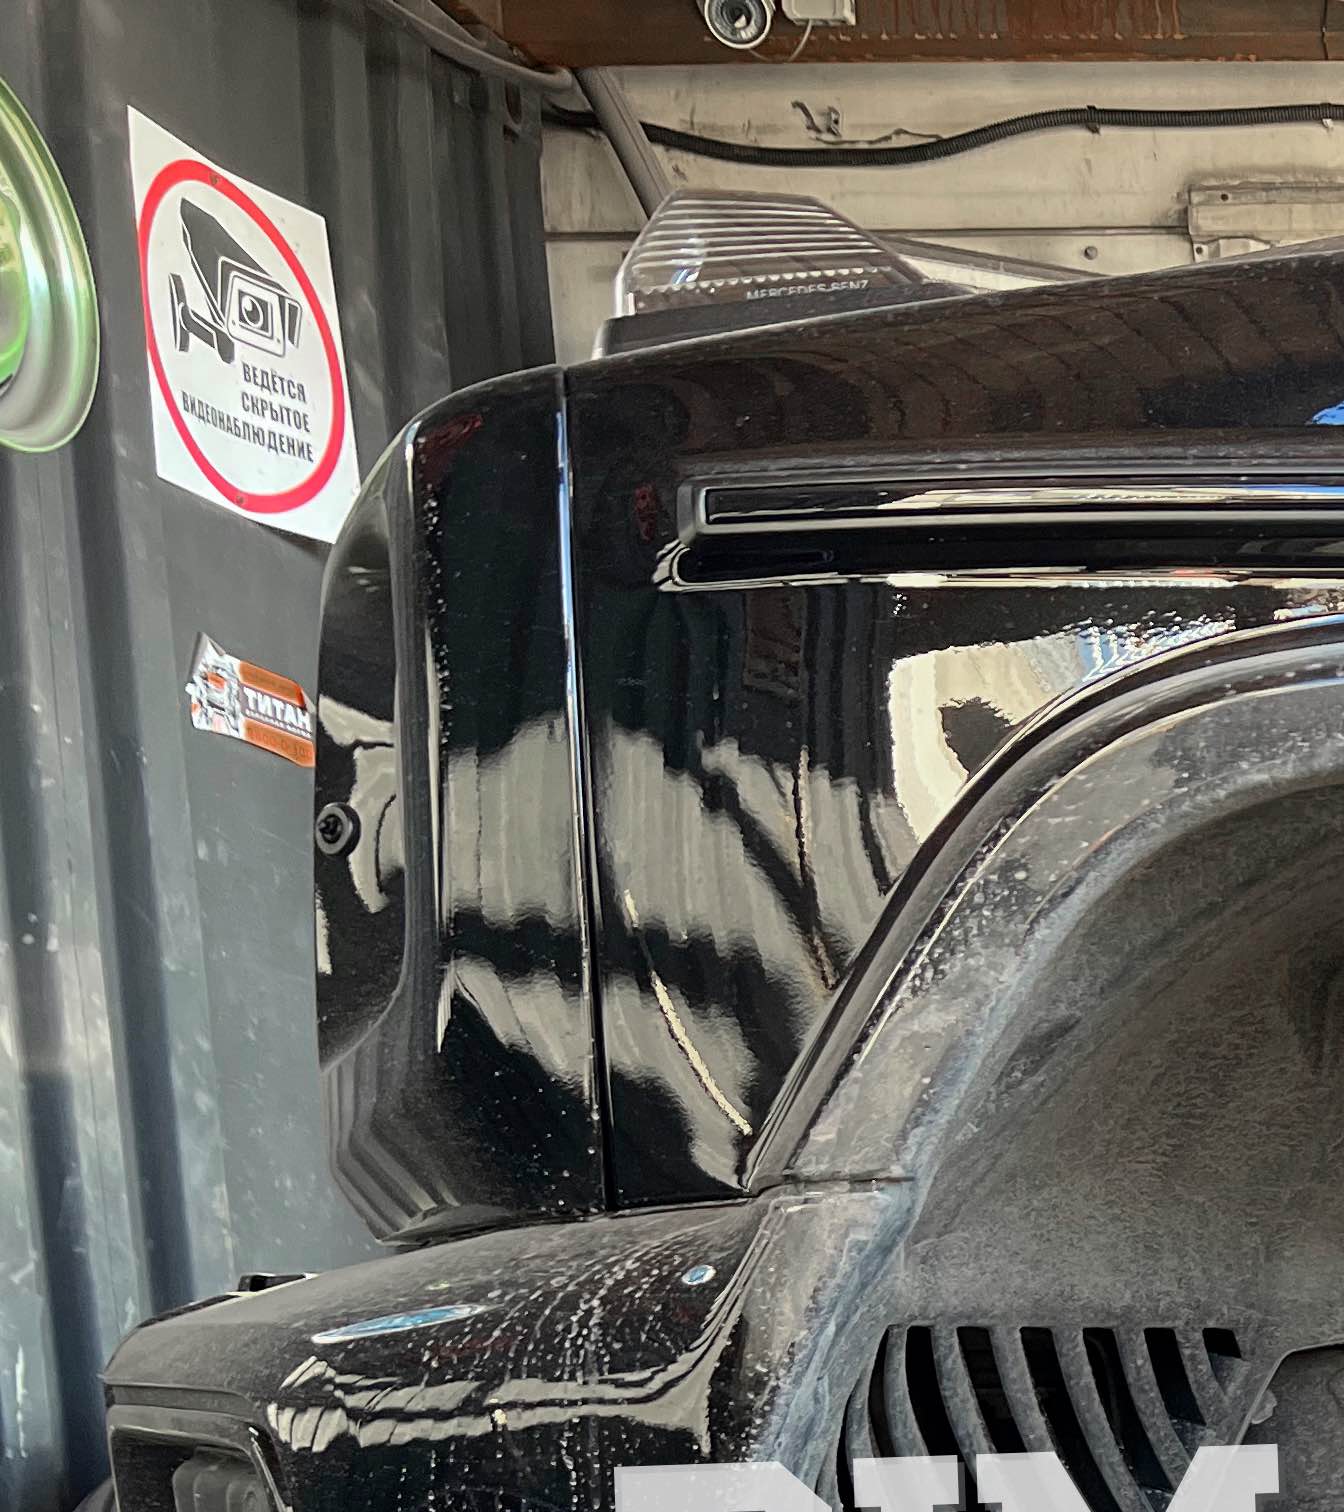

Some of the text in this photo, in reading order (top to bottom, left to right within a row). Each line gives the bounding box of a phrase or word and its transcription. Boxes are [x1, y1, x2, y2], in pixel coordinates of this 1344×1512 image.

[242, 361, 307, 404] ВЕДЁТСЯ
[181, 391, 314, 463] ВИДЕОНАБЛЮДЕНИЕ
[241, 391, 311, 433] СКРЫТОЕ
[243, 685, 313, 735] ТИТАН
